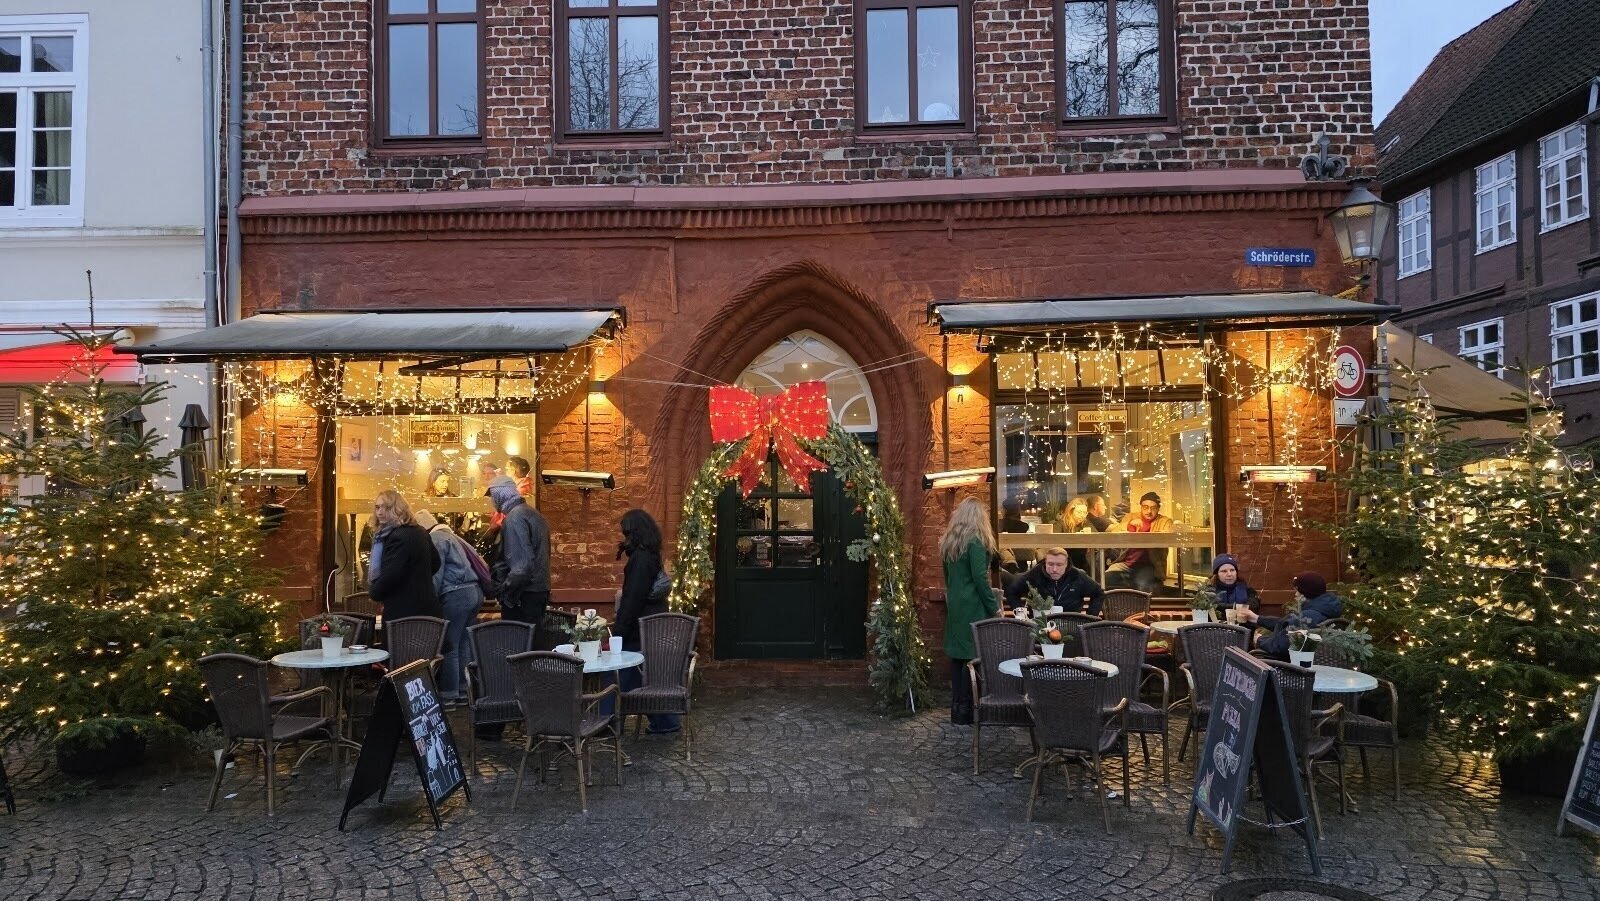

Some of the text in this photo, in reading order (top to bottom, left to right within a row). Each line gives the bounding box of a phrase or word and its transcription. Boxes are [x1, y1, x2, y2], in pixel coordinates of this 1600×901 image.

[1250, 250, 1311, 263] Schröderstr.
[405, 677, 426, 701] BIER
[419, 690, 435, 710] FASS
[1221, 701, 1241, 733] PIZZA
